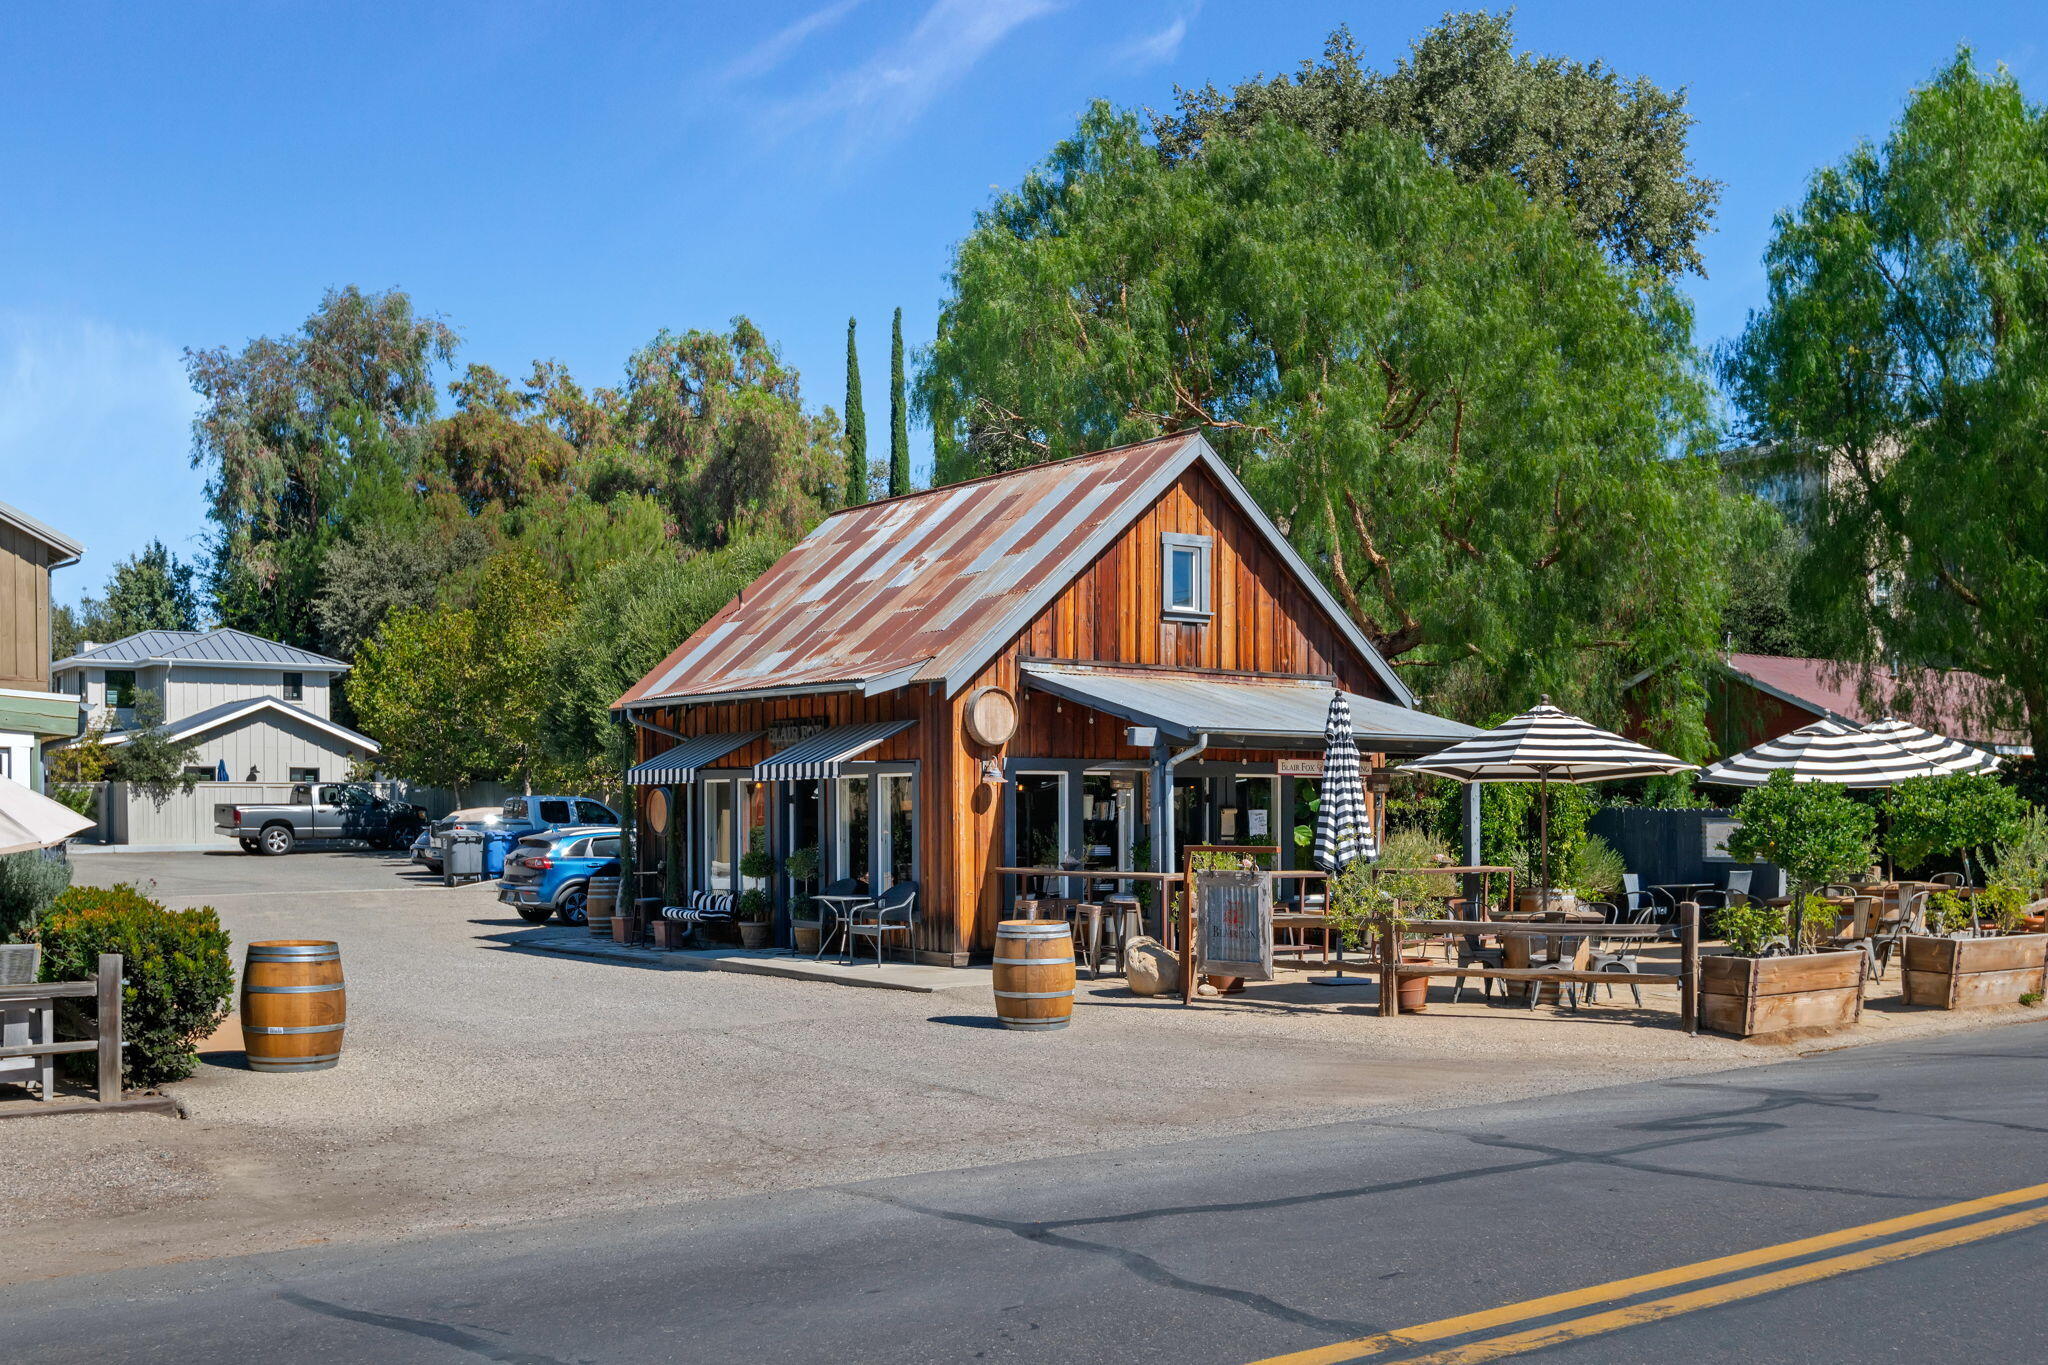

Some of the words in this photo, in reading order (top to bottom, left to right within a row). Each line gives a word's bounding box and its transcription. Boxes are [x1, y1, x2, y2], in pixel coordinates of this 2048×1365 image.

[768, 726, 799, 741] BLAIR
[1281, 762, 1300, 771] BLAIR
[1301, 762, 1315, 772] FOX
